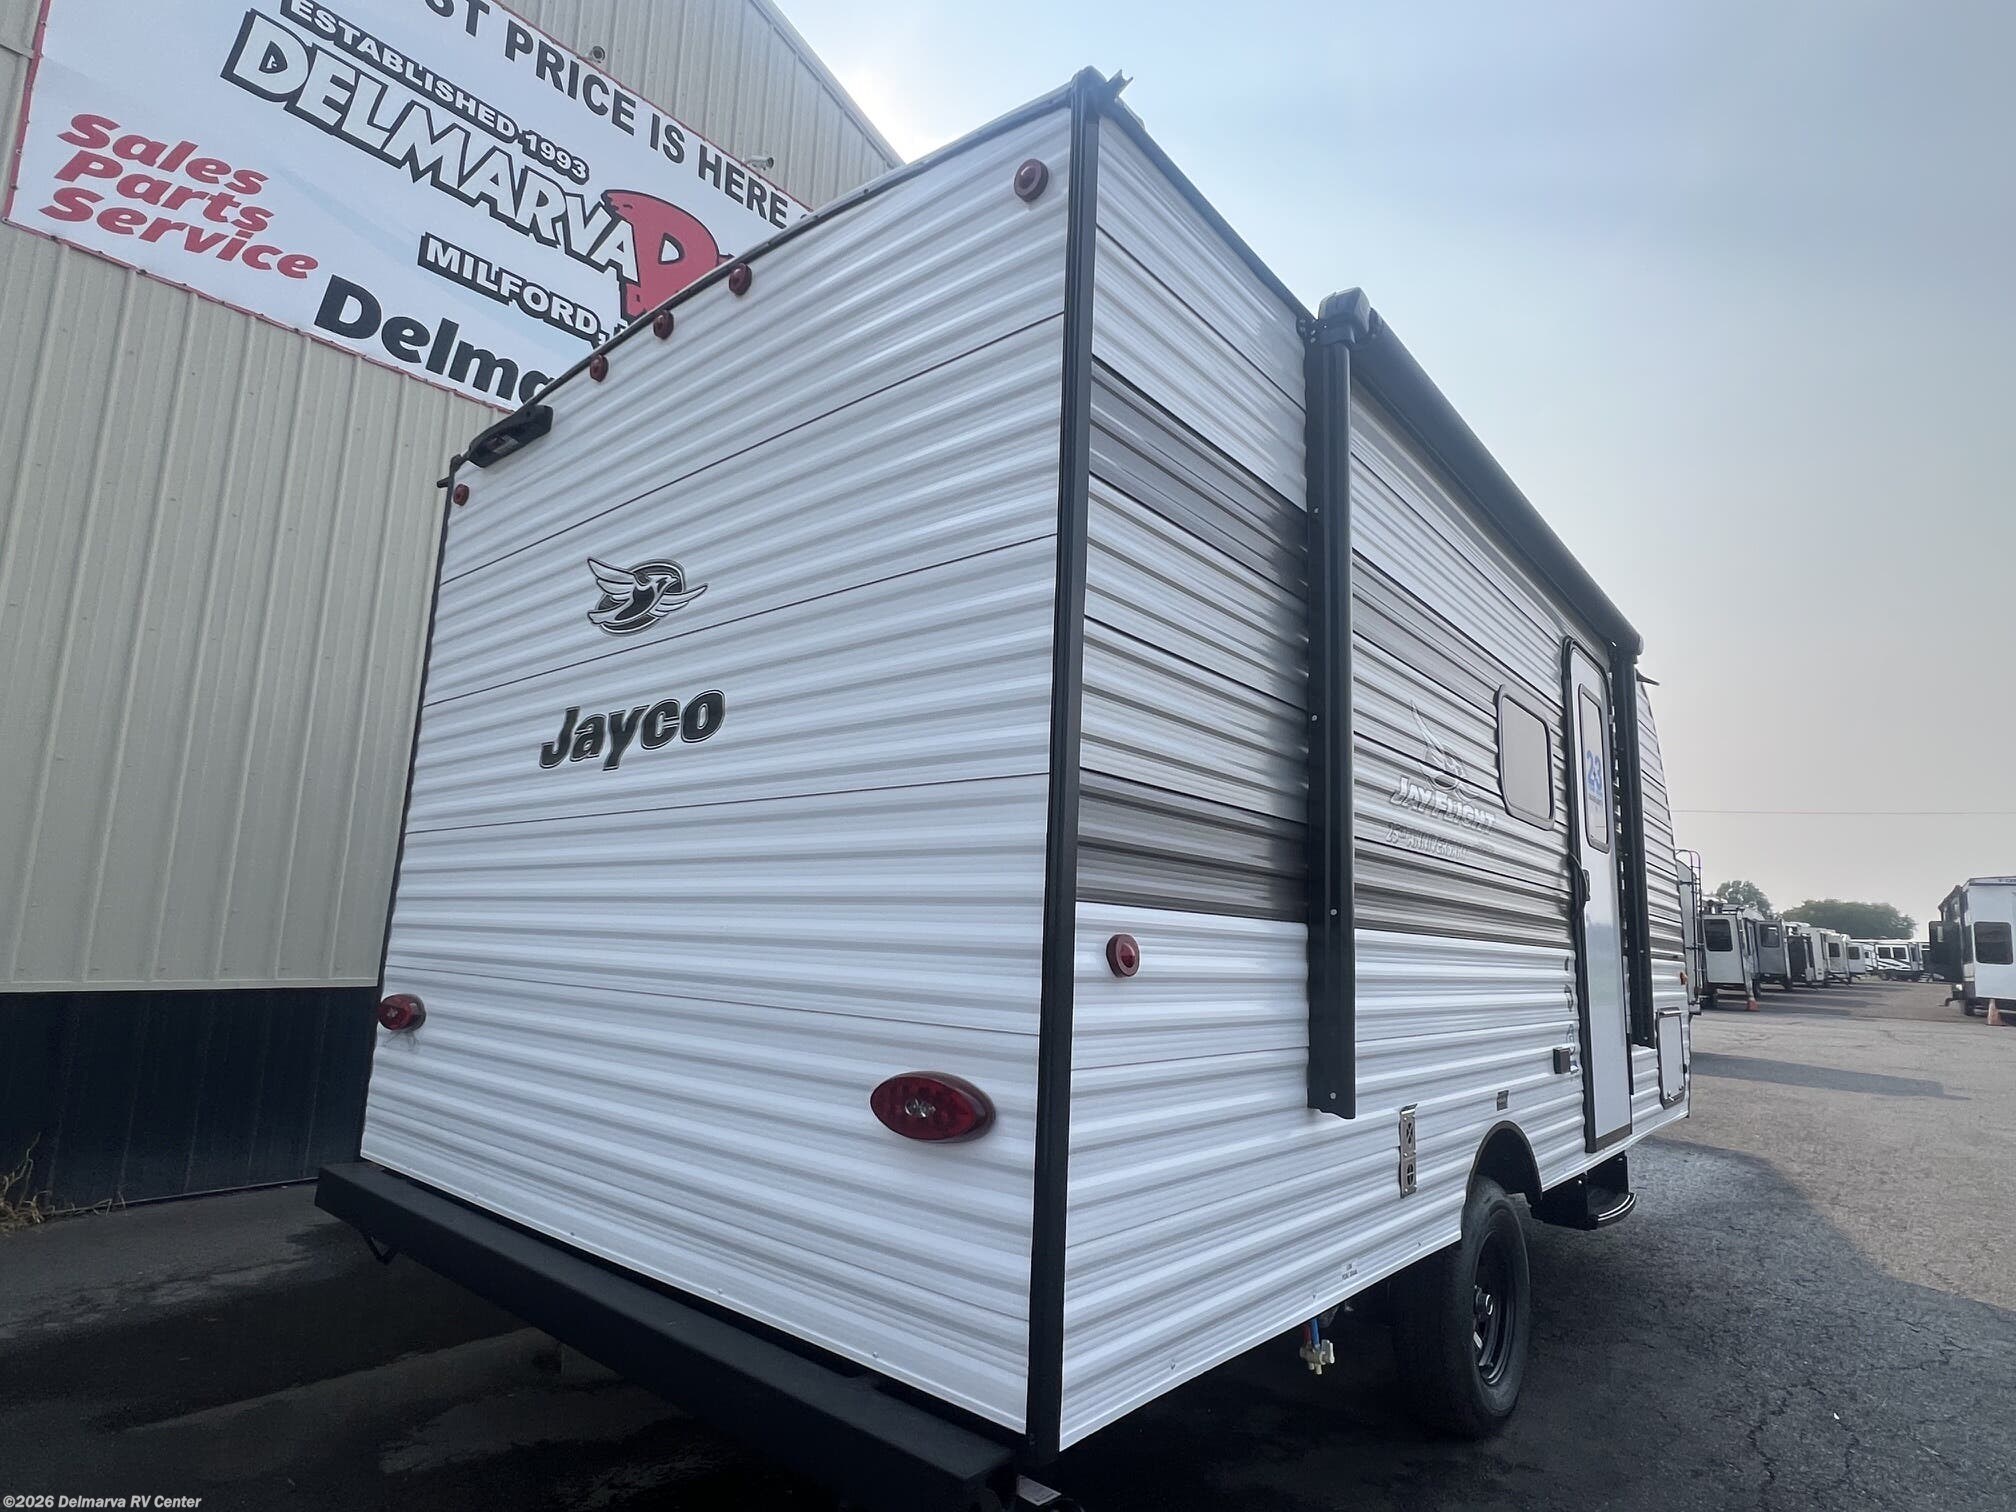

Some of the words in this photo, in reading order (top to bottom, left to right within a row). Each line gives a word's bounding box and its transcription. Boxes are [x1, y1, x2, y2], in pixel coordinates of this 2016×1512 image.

[288, 0, 516, 138] ESTABLISHED
[525, 134, 587, 179] 1993
[505, 19, 636, 136] PRICE
[649, 113, 686, 164] IS
[698, 144, 788, 229] HERE
[54, 150, 274, 232] Parts
[57, 113, 269, 195] Sales
[225, 10, 639, 284] DELMARVA
[38, 187, 319, 279] Service
[540, 690, 726, 771] Jayco
